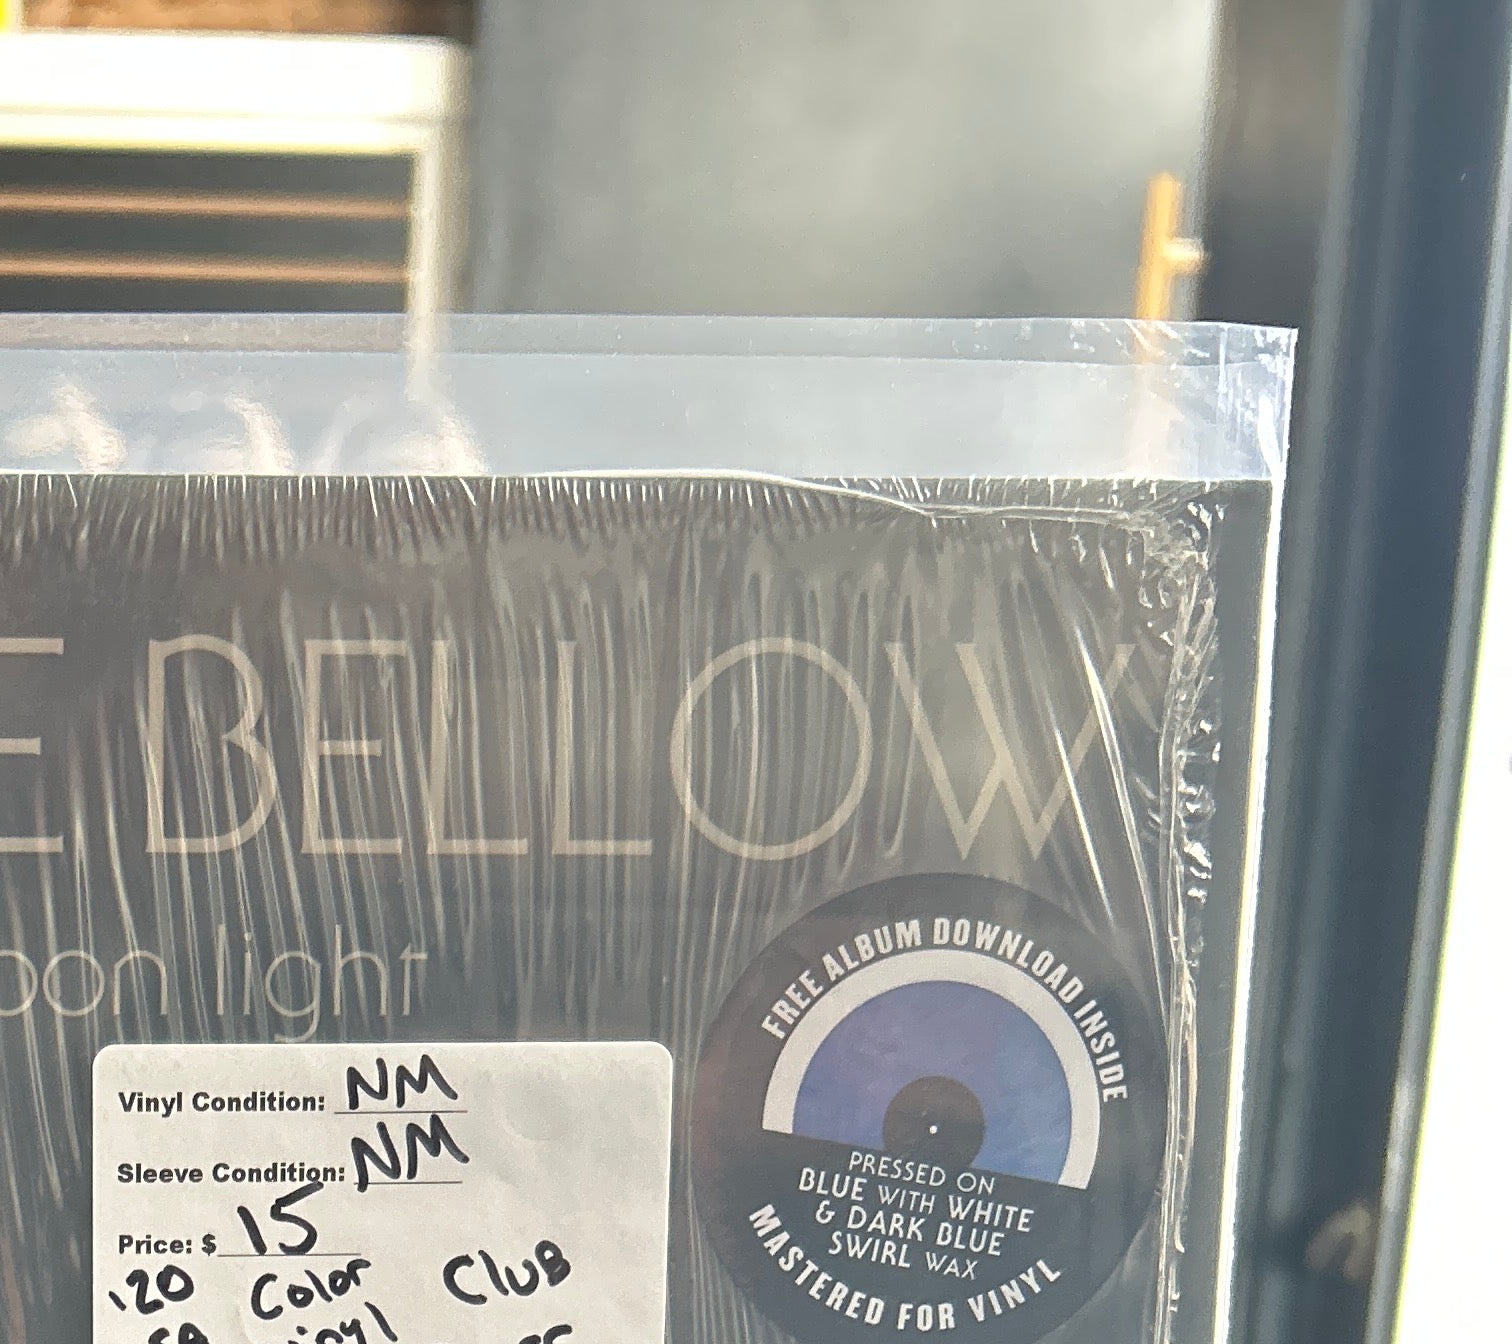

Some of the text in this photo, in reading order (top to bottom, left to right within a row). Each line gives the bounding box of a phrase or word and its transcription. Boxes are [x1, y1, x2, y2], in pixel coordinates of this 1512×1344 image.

[143, 633, 1138, 862] BELLOW
[216, 922, 430, 1043] light
[761, 917, 1129, 1103] FREE ALBUM DOWNLOAD INSIDE
[118, 1054, 458, 1117] Vinyl Condition: NM
[116, 1114, 470, 1192] Sleeve Condition: NM
[849, 1151, 996, 1195] PRESSED ON
[798, 1167, 1035, 1233] BLUE WITH WHITE
[815, 1199, 1006, 1257] & DARK BLUE
[117, 1234, 192, 1256] Price:
[749, 1203, 1062, 1332] MASTERED FOR VINYL
[827, 1229, 979, 1281] SWIRL WAX
